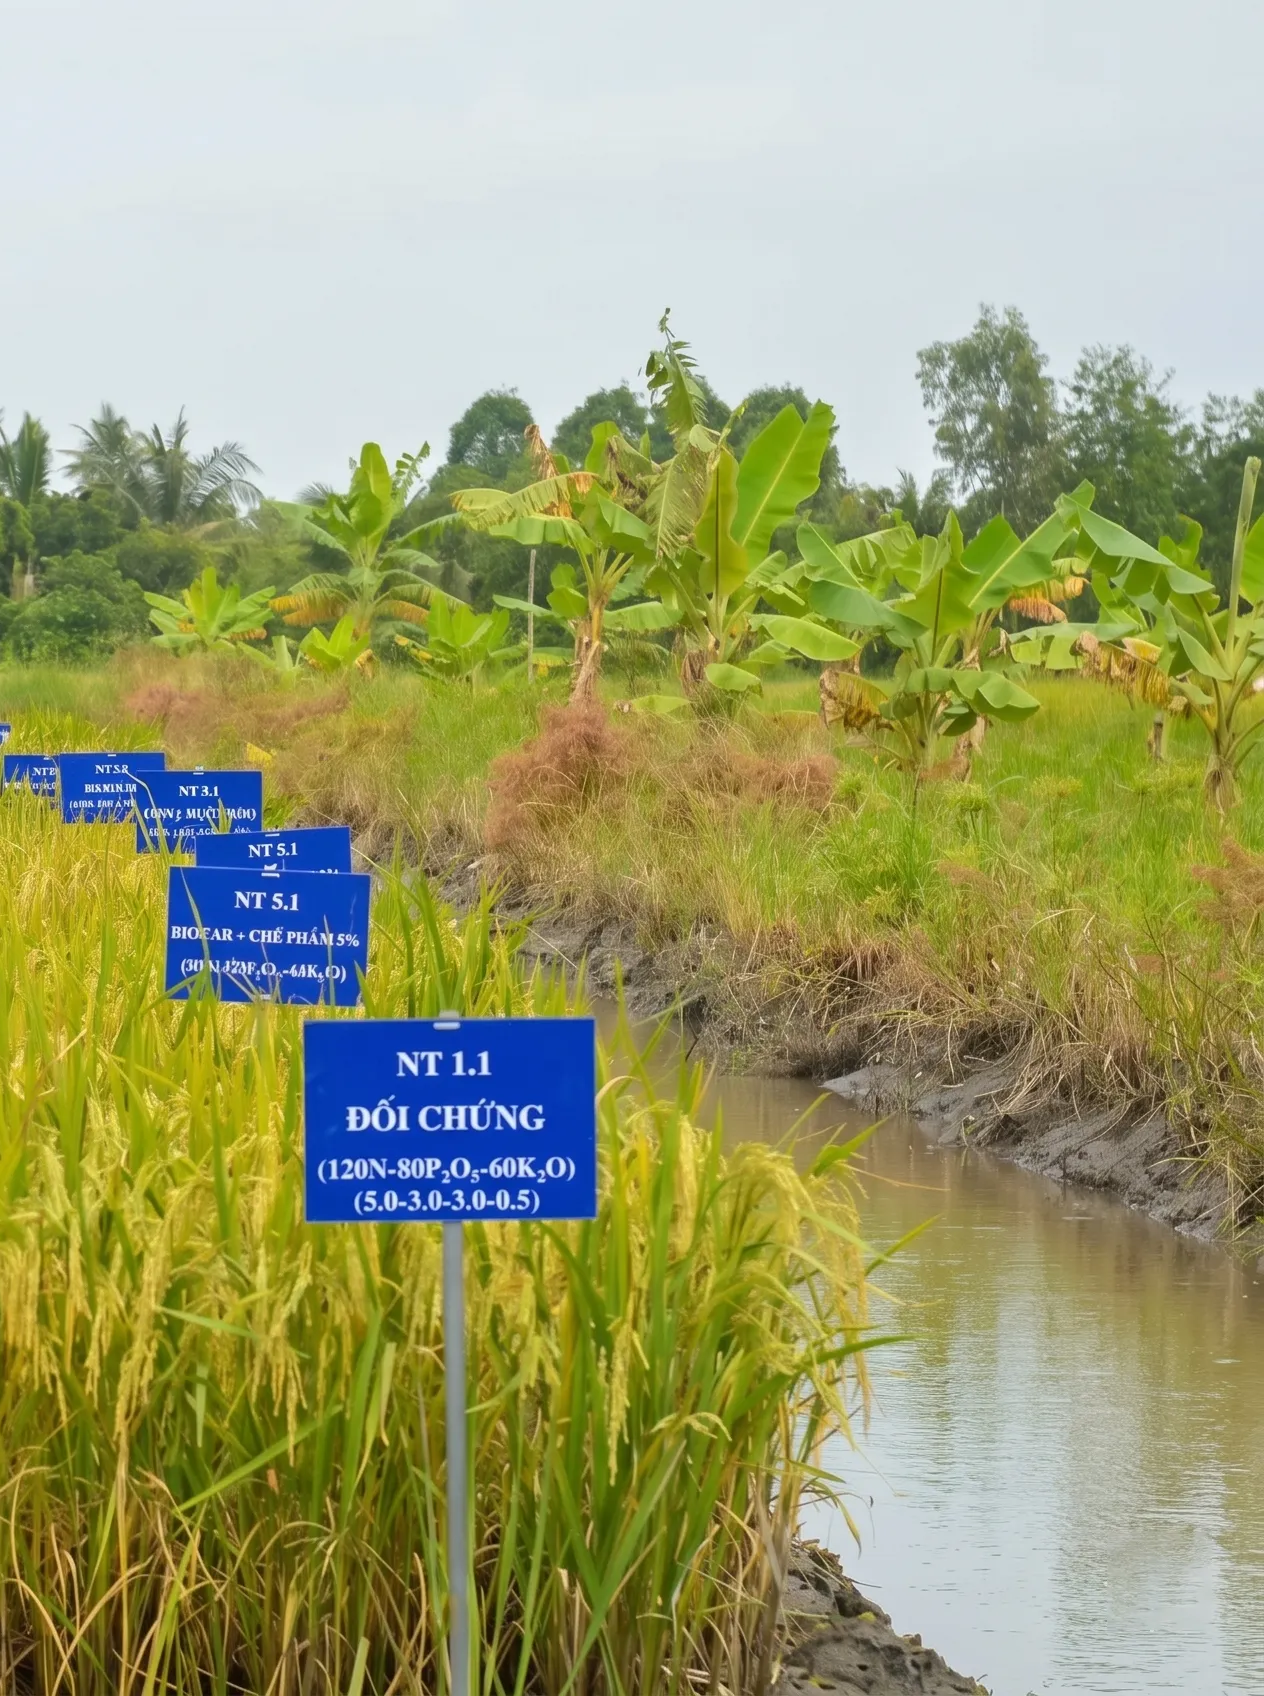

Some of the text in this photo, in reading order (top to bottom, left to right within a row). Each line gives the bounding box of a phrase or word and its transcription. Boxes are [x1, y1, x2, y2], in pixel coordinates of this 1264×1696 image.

[178, 785, 219, 797] NT 3.1
[247, 842, 298, 858] NT 5.1
[234, 890, 299, 911] NT 5.1
[335, 933, 361, 948] 5%
[396, 1050, 492, 1077] NT 1.1
[345, 1095, 547, 1132] ĐỐI CHỨNG
[354, 1189, 541, 1215] (5.0-3.0-3.0-0.5)
